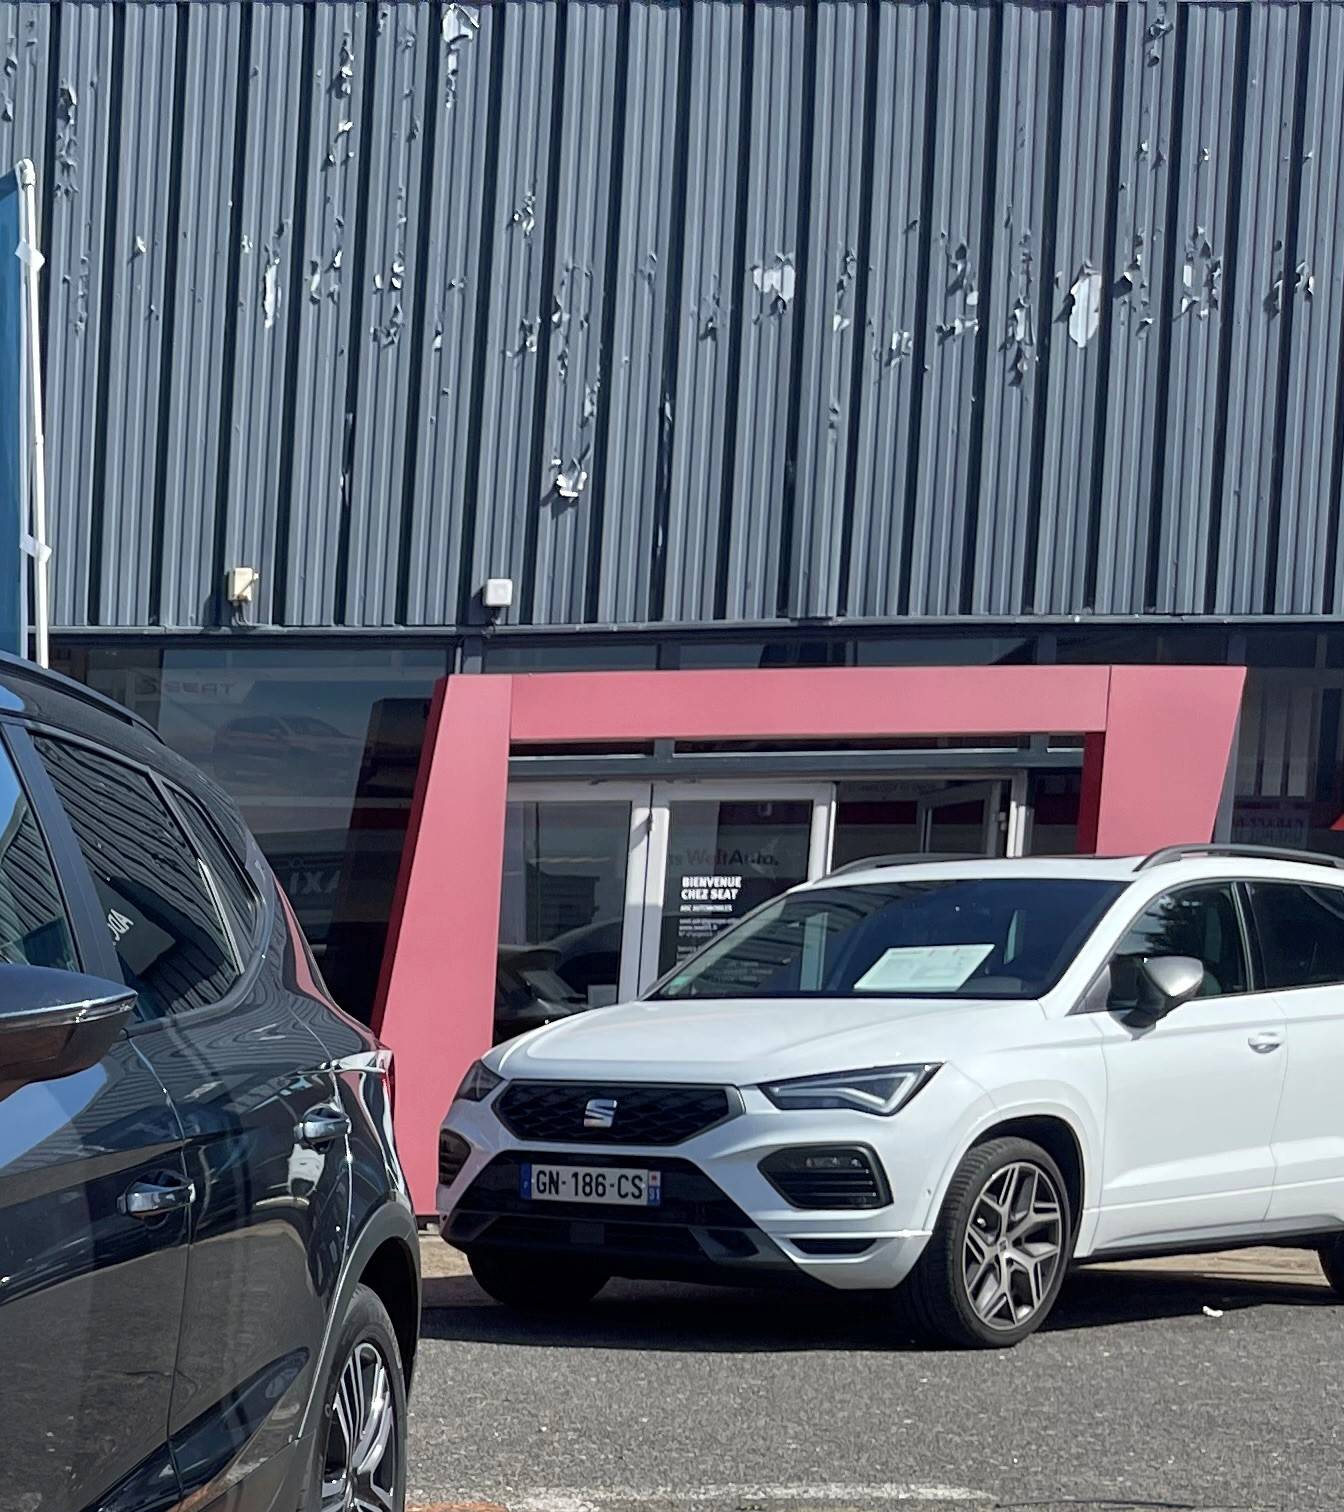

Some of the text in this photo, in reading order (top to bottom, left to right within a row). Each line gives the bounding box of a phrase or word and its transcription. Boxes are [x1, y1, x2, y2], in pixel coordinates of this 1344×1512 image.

[681, 876, 742, 888] BIENVENUE
[680, 888, 738, 900] CHEZ SEAT
[535, 1170, 643, 1199] GN-186-CS
